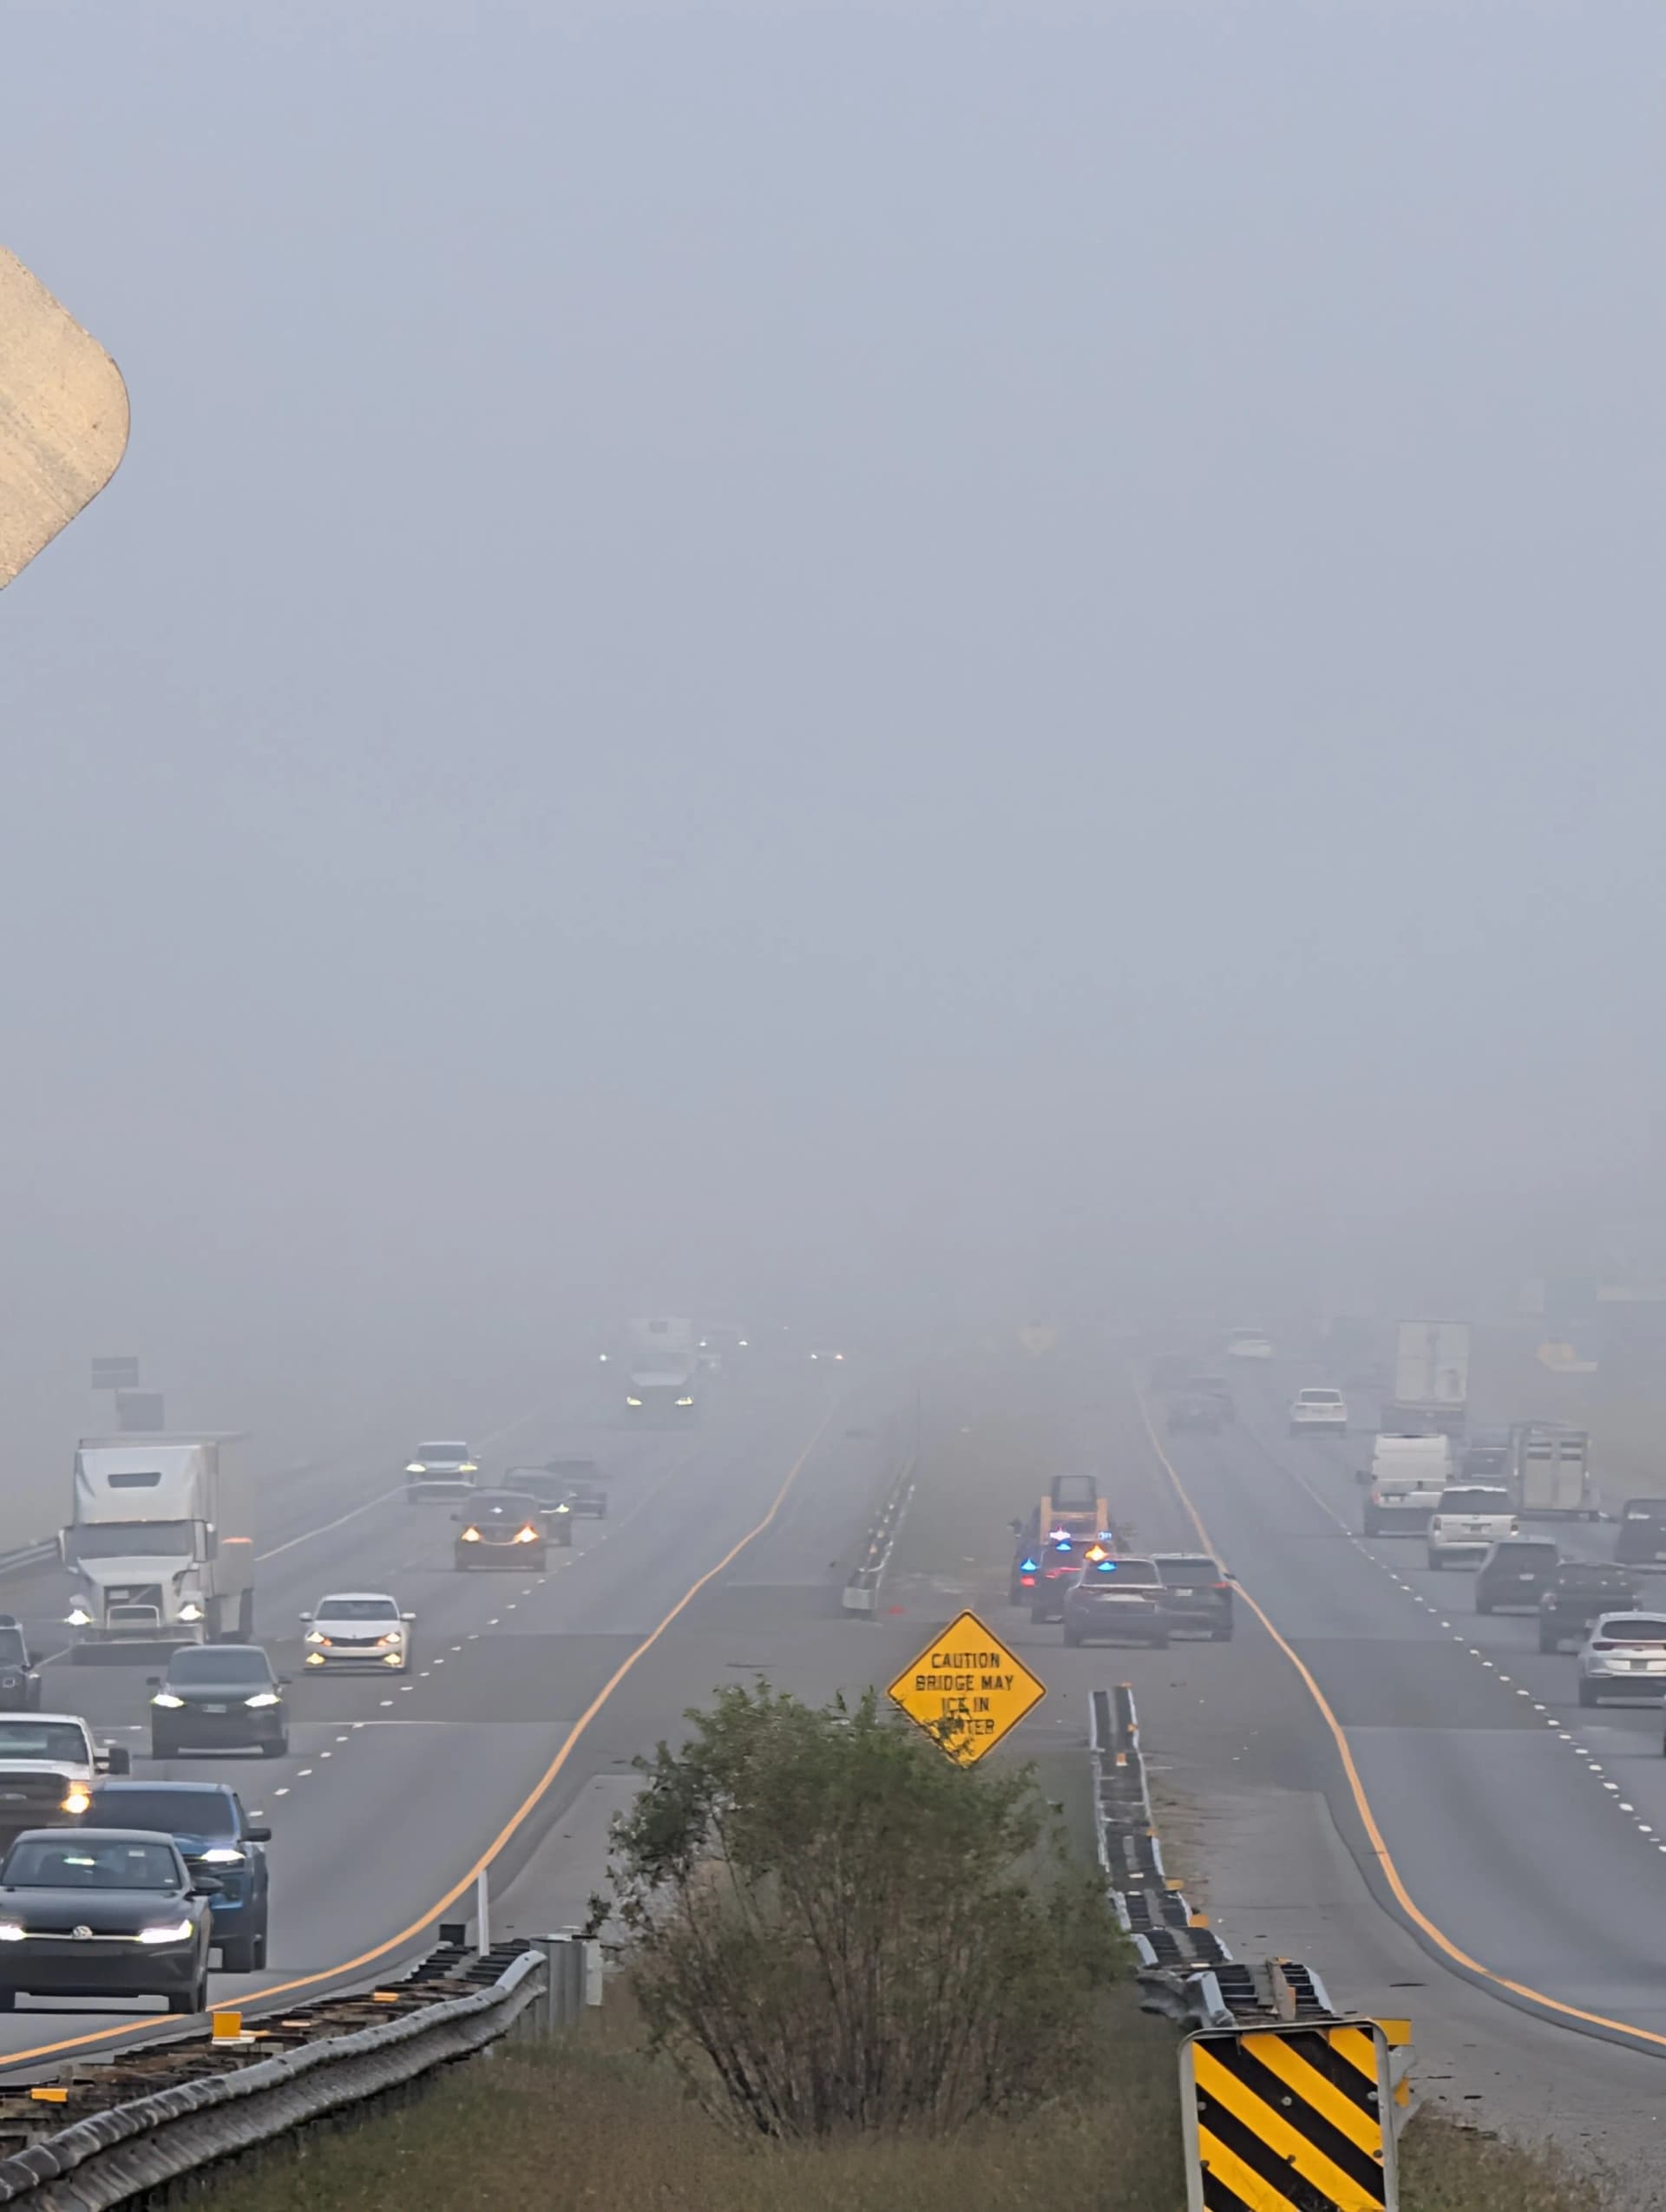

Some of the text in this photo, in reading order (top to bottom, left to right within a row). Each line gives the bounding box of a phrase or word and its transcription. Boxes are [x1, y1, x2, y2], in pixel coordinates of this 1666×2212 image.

[931, 1652, 1000, 1668] CAUTION
[916, 1675, 1013, 1691] BRIDGE MAY
[974, 1698, 989, 1712] IN
